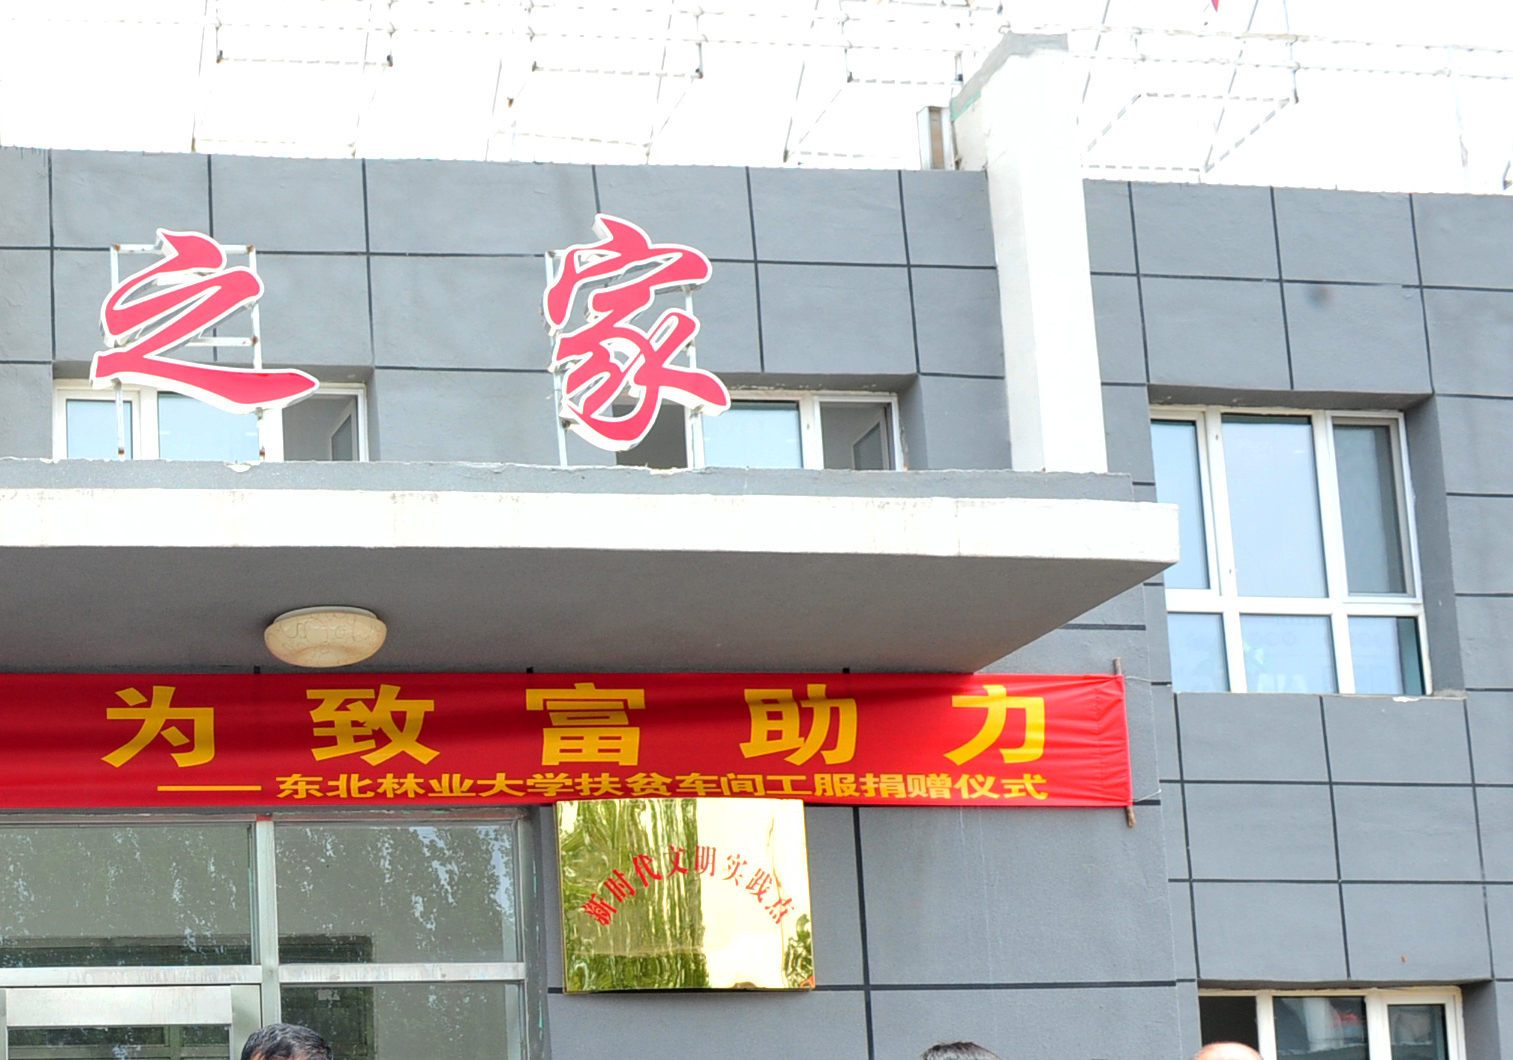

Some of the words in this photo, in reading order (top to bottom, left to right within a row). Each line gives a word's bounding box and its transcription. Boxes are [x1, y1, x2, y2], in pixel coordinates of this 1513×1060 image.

[100, 683, 1046, 768] 为致富助力
[581, 844, 795, 926] 新时代文明实践点
